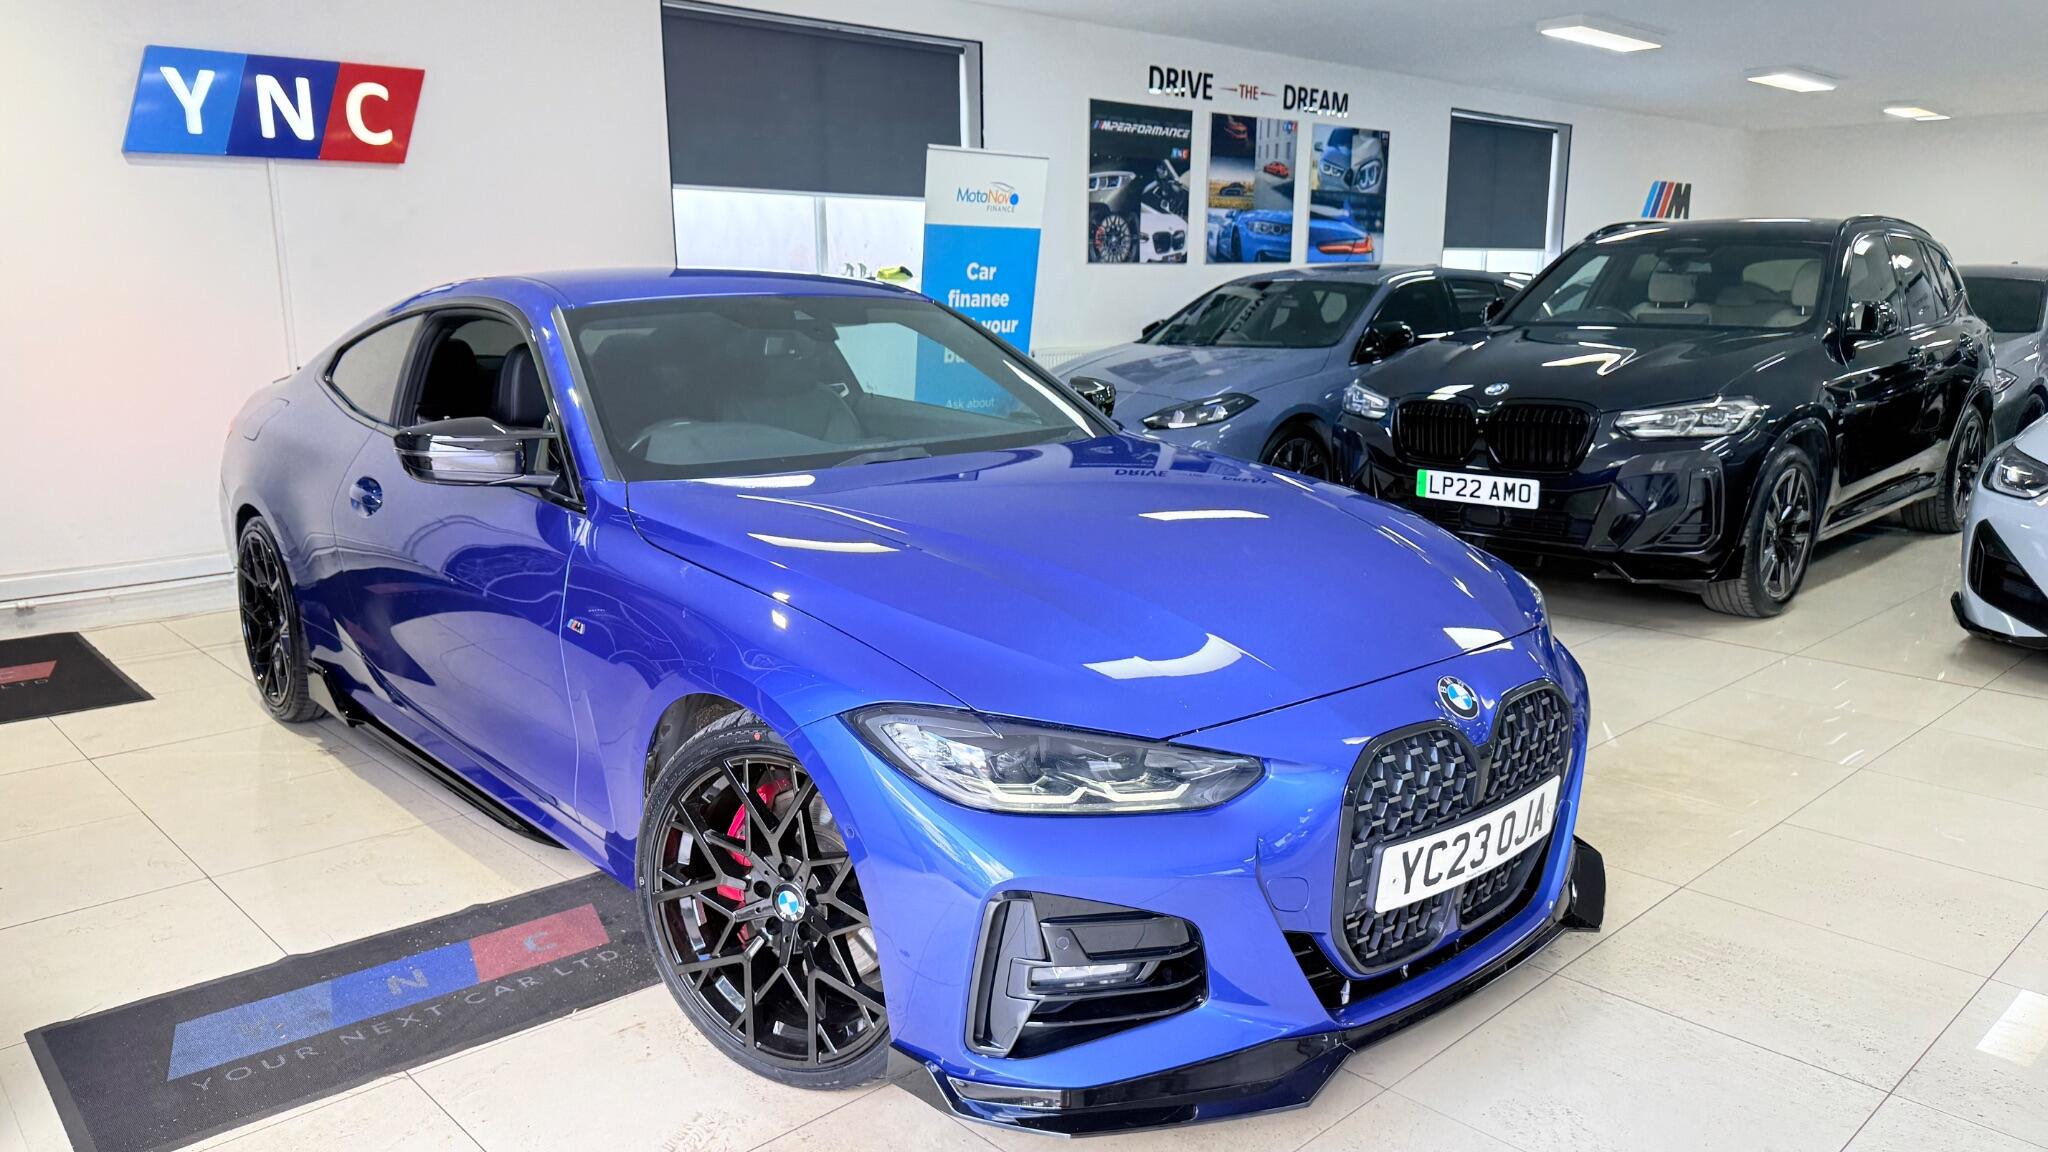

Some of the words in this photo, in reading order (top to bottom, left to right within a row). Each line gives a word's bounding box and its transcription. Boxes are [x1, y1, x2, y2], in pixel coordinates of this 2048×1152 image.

[1149, 65, 1214, 101] DRIVE
[1238, 84, 1260, 101] THE
[1283, 84, 1349, 117] DREAM
[159, 66, 394, 146] YNC
[986, 204, 1015, 213] FINANCE
[966, 262, 997, 281] Car
[948, 289, 1010, 308] finance
[945, 398, 964, 409] Ask
[966, 396, 995, 409] about
[1429, 475, 1482, 499] LP22
[1489, 481, 1532, 503] AMO
[1402, 823, 1492, 895] YC23
[1497, 792, 1546, 856] OJA
[191, 1046, 321, 1091] YOUR
[339, 1004, 442, 1046] NEXT
[463, 976, 538, 1005] CAR
[552, 950, 619, 977] LTD
